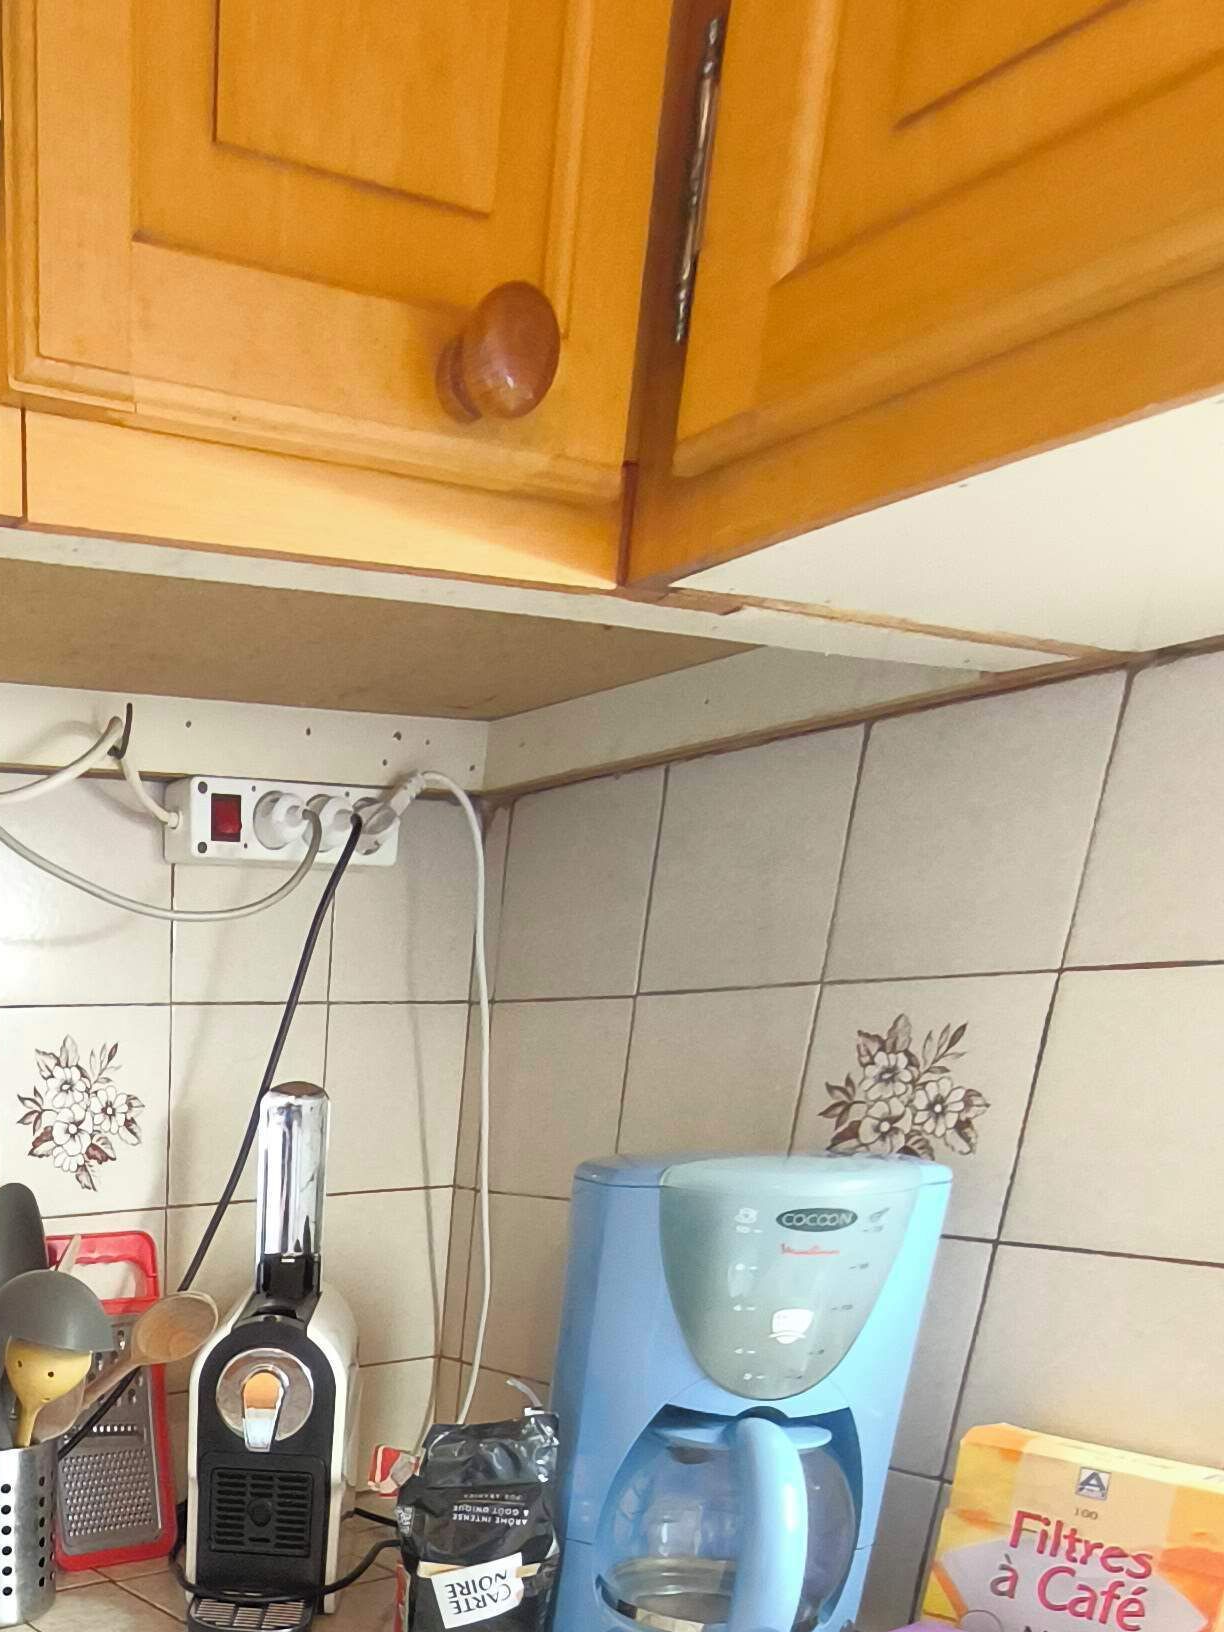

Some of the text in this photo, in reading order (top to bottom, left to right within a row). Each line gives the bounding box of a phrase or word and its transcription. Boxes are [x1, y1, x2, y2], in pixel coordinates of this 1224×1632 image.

[781, 1212, 854, 1227] COCOON
[1074, 1507, 1099, 1521] 100
[1008, 1509, 1155, 1580] Filtres
[444, 1569, 508, 1600] NOIRE
[453, 1583, 512, 1616] CARTE
[989, 1553, 1149, 1632] à Café
